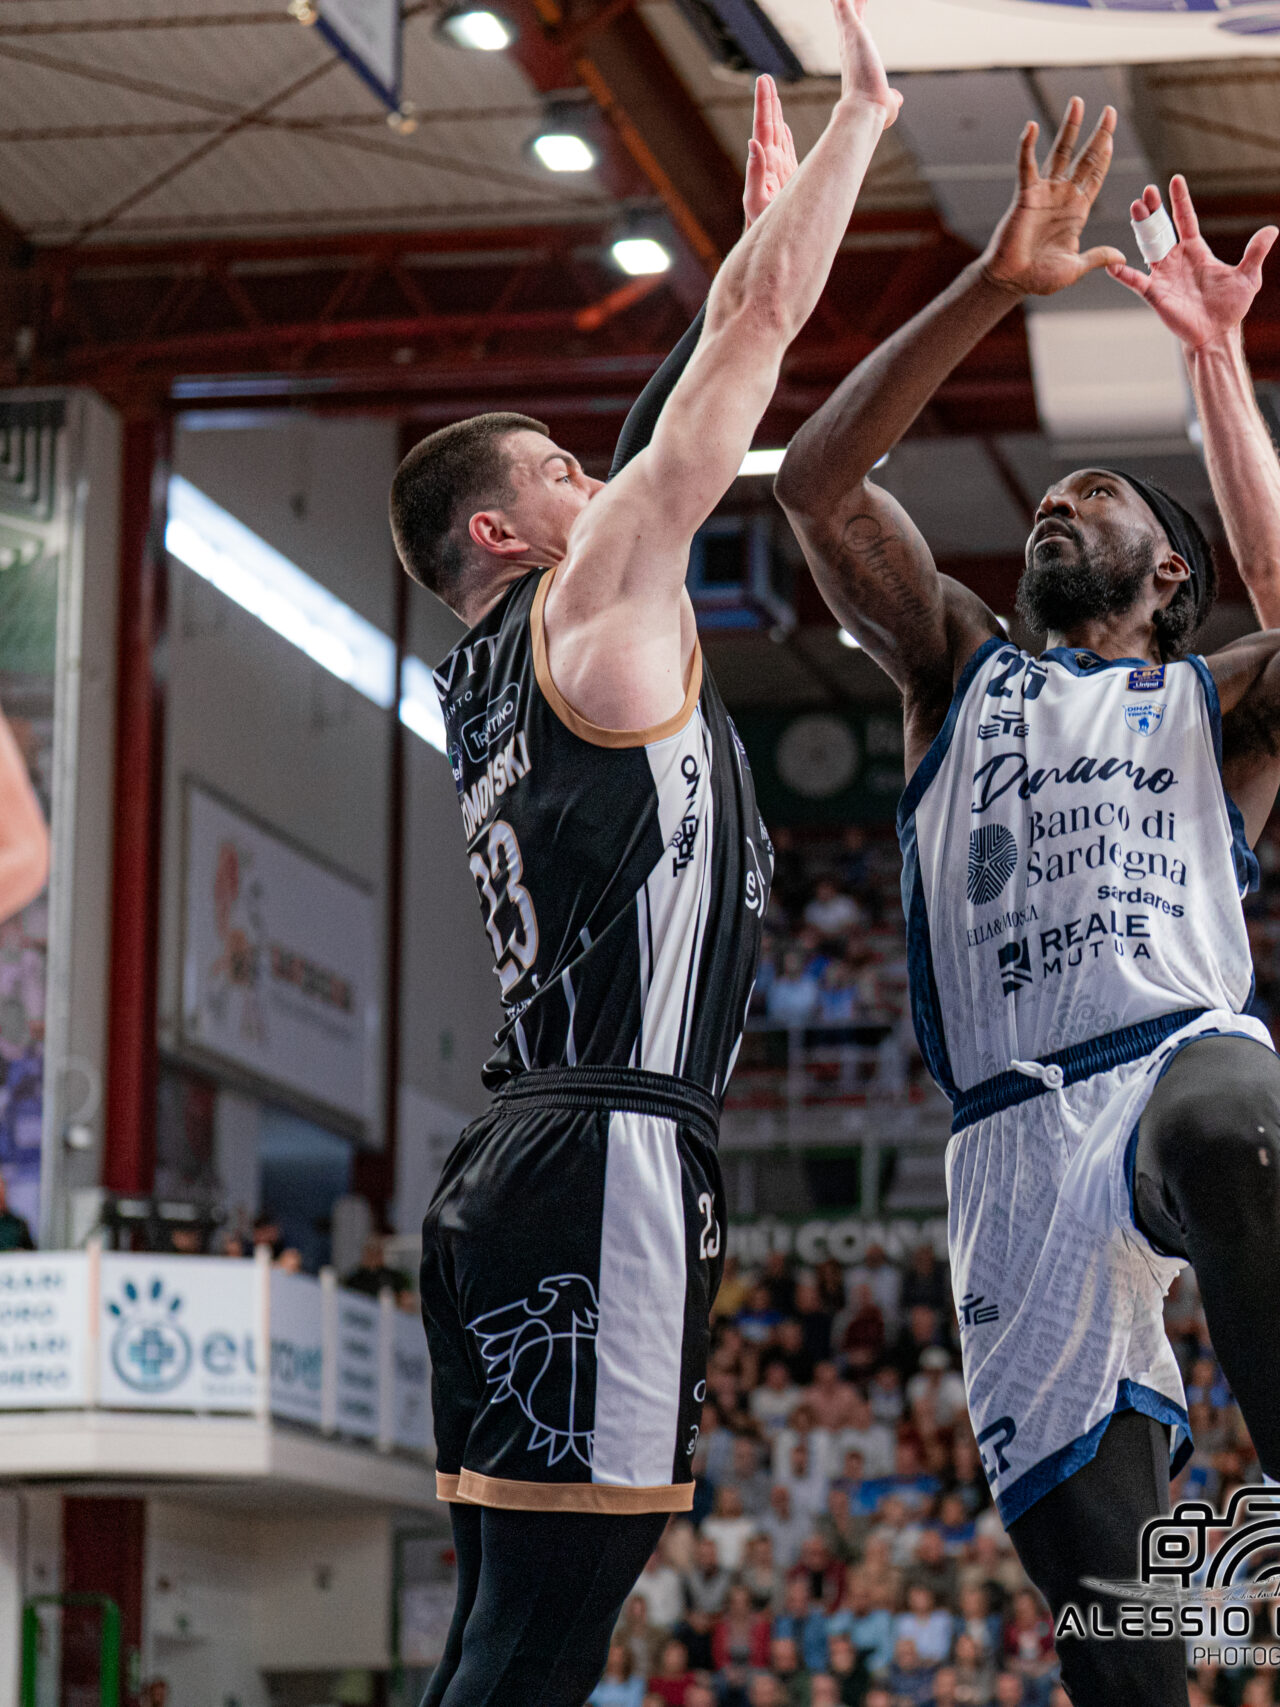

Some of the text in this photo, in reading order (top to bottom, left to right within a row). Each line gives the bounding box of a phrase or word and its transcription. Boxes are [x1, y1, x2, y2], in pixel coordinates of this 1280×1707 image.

[432, 633, 500, 701] VIT
[1027, 801, 1177, 848] Banco di
[1026, 836, 1188, 888] Sardegna
[1039, 910, 1152, 958] REALE
[1042, 940, 1152, 979] MUTUA
